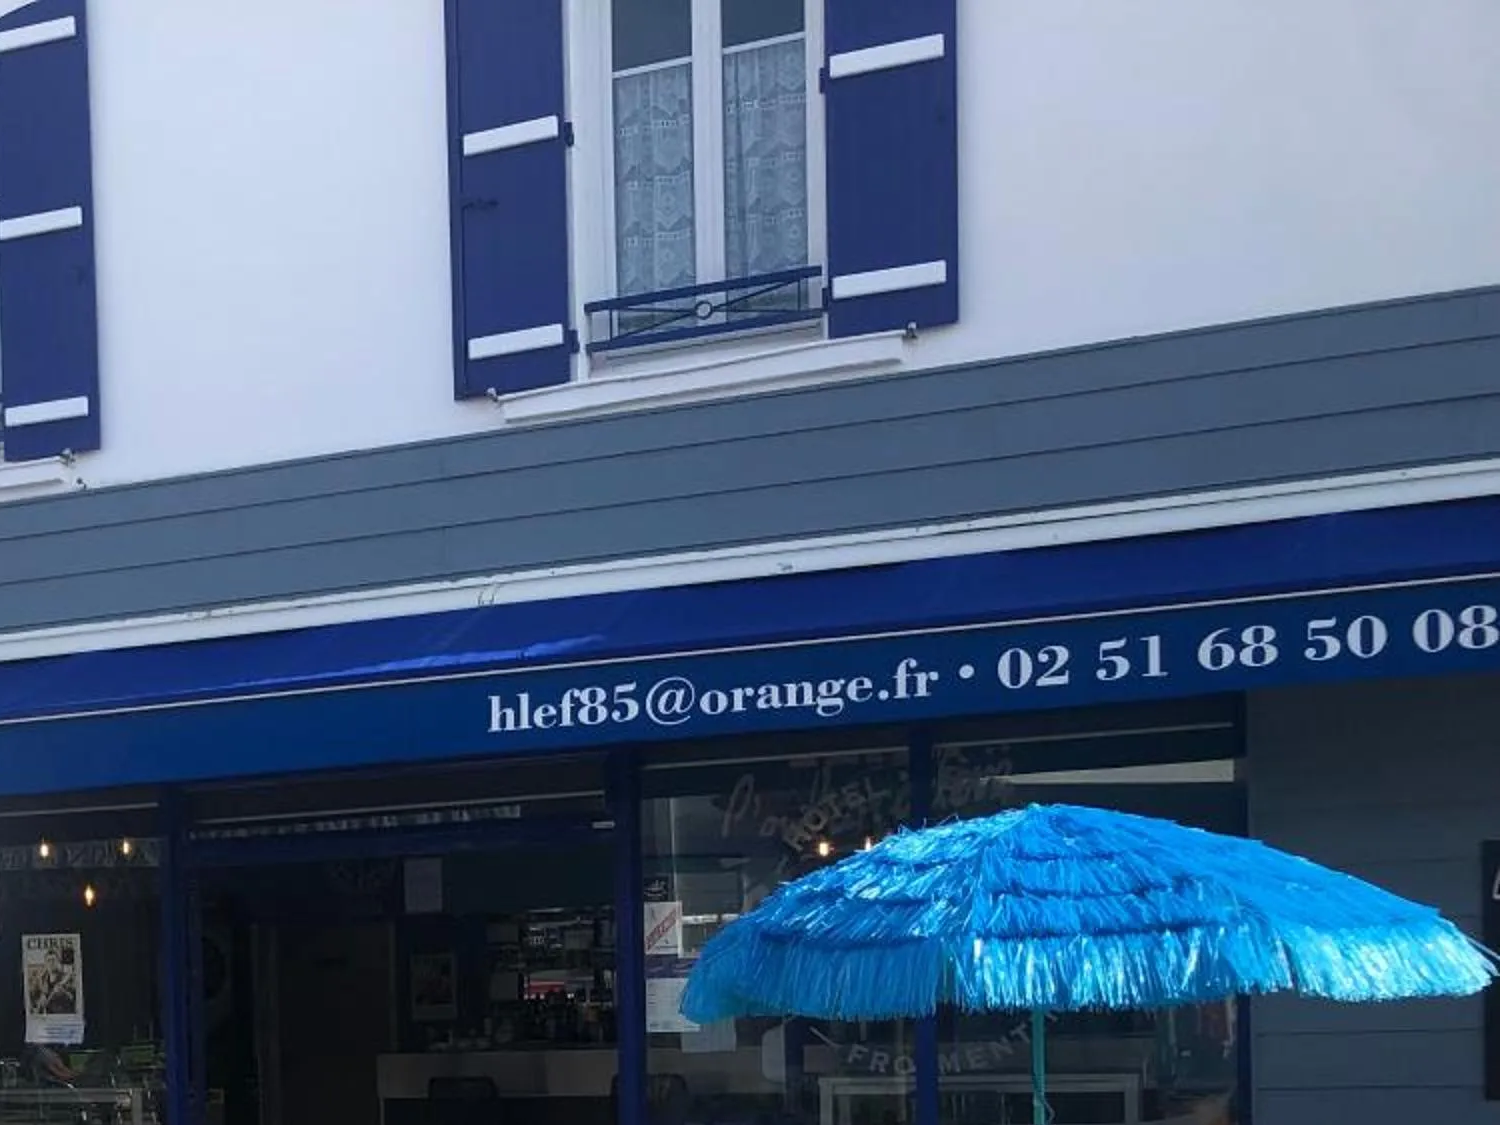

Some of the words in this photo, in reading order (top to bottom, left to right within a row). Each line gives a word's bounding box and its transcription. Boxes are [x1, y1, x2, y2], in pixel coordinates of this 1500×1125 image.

[487, 656, 940, 733] hlef85@orange.fr
[997, 645, 1071, 689] 02
[1096, 635, 1169, 683] 51
[1197, 624, 1279, 671] 68
[1303, 614, 1388, 661] 50
[1413, 605, 1499, 653] 08
